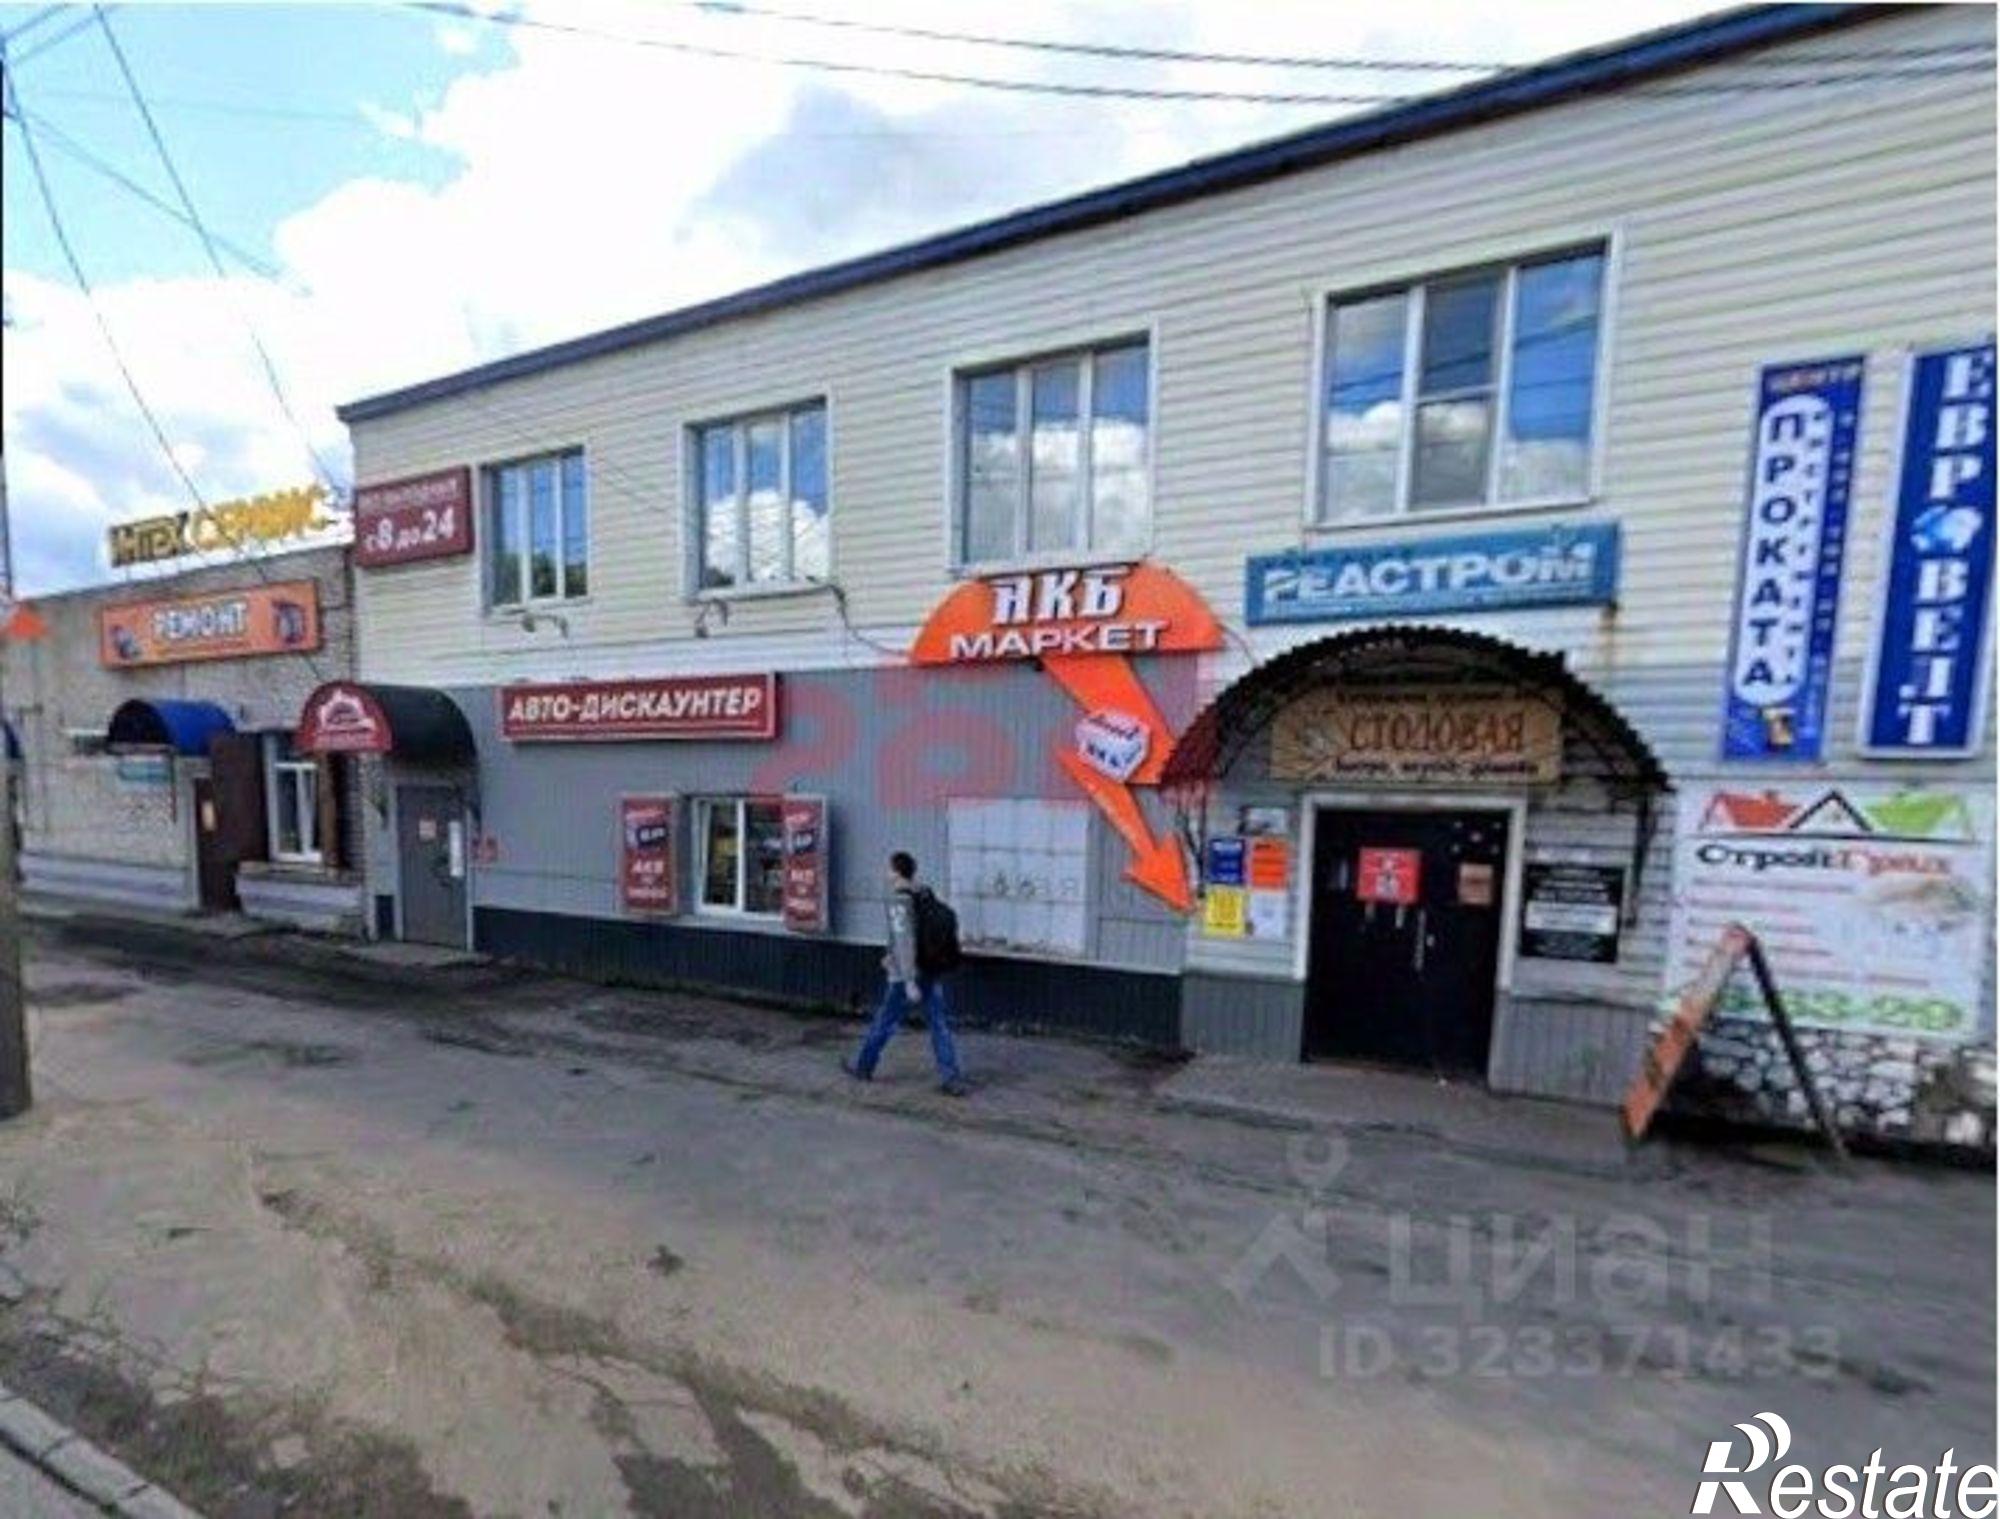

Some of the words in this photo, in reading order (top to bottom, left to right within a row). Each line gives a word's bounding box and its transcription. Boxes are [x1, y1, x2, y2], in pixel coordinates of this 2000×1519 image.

[377, 518, 392, 550] 8
[422, 506, 454, 542] 24
[1743, 411, 1804, 686] ПРОКАТА
[991, 566, 1129, 625] АКБ
[153, 601, 247, 643] РЕМОНТ
[950, 619, 1172, 658] МАРКЕТ
[508, 688, 763, 723] АВТО-ДИСКАУНТЕР
[1350, 711, 1524, 752] СТОЛОВАЯ
